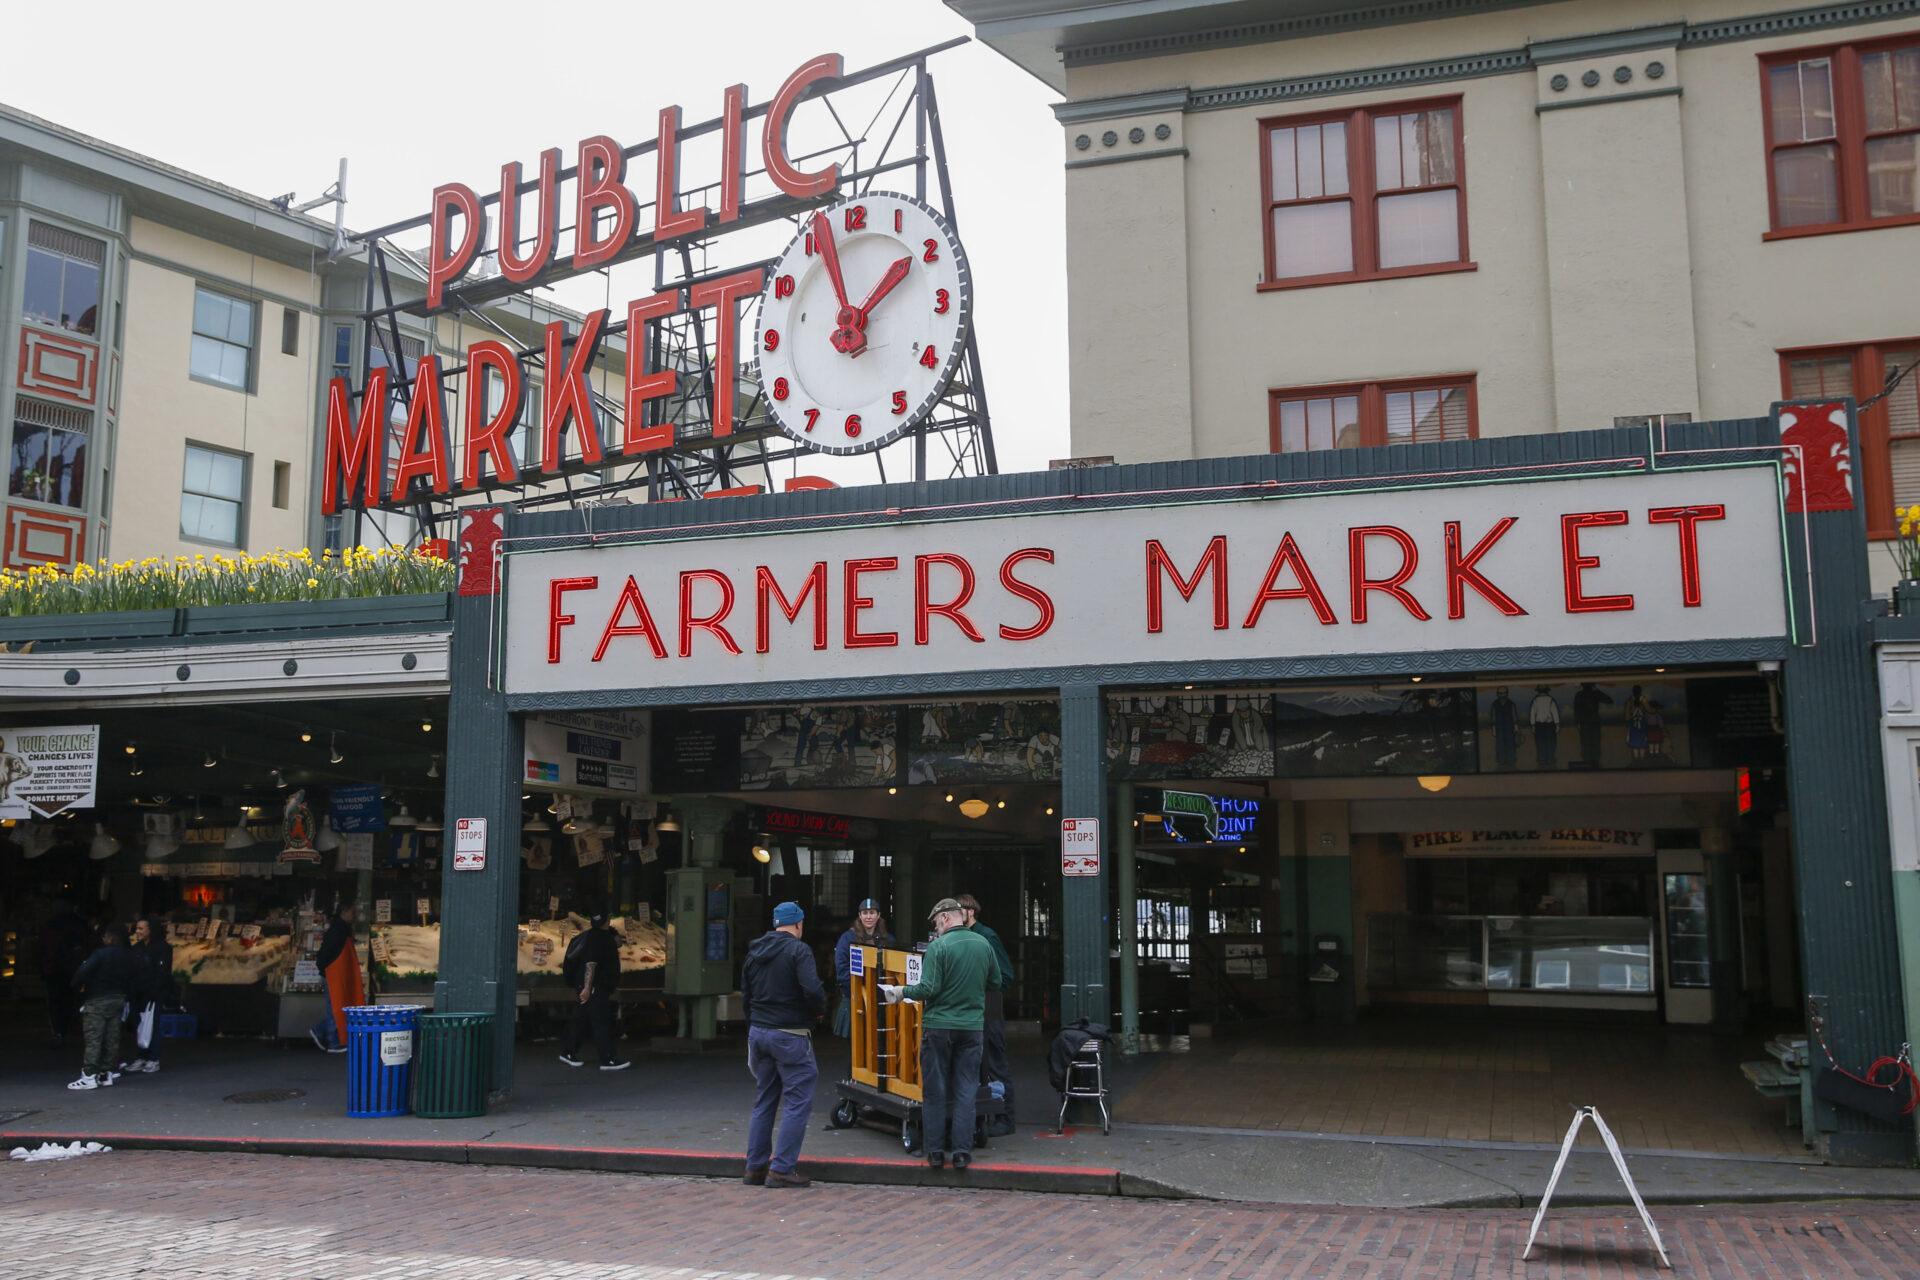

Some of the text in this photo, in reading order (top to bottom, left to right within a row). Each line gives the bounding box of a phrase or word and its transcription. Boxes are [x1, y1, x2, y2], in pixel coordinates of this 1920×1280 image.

[427, 53, 844, 308] PUBLIC
[845, 206, 867, 232] 12
[895, 209, 903, 233] 1
[923, 238, 939, 263] 2
[775, 275, 795, 299] 10
[934, 288, 949, 314] 3
[764, 329, 779, 351] 9
[920, 345, 938, 369] 4
[322, 267, 769, 515] MARKET
[774, 377, 789, 401] 8
[892, 391, 907, 414] 5
[804, 408, 820, 432] 7
[845, 414, 861, 438] 6
[548, 504, 1725, 664] FARMERS MARKET
[17, 734, 95, 753] YOUR CHANGE
[28, 753, 66, 761] CHANGES
[460, 831, 482, 840] STOPS
[1064, 821, 1074, 829] NO
[1218, 817, 1256, 832] OINT
[1067, 833, 1094, 841] STOPS
[1413, 831, 1462, 848] PIKE
[1551, 830, 1643, 846] BAKERY
[909, 959, 919, 970] CDs
